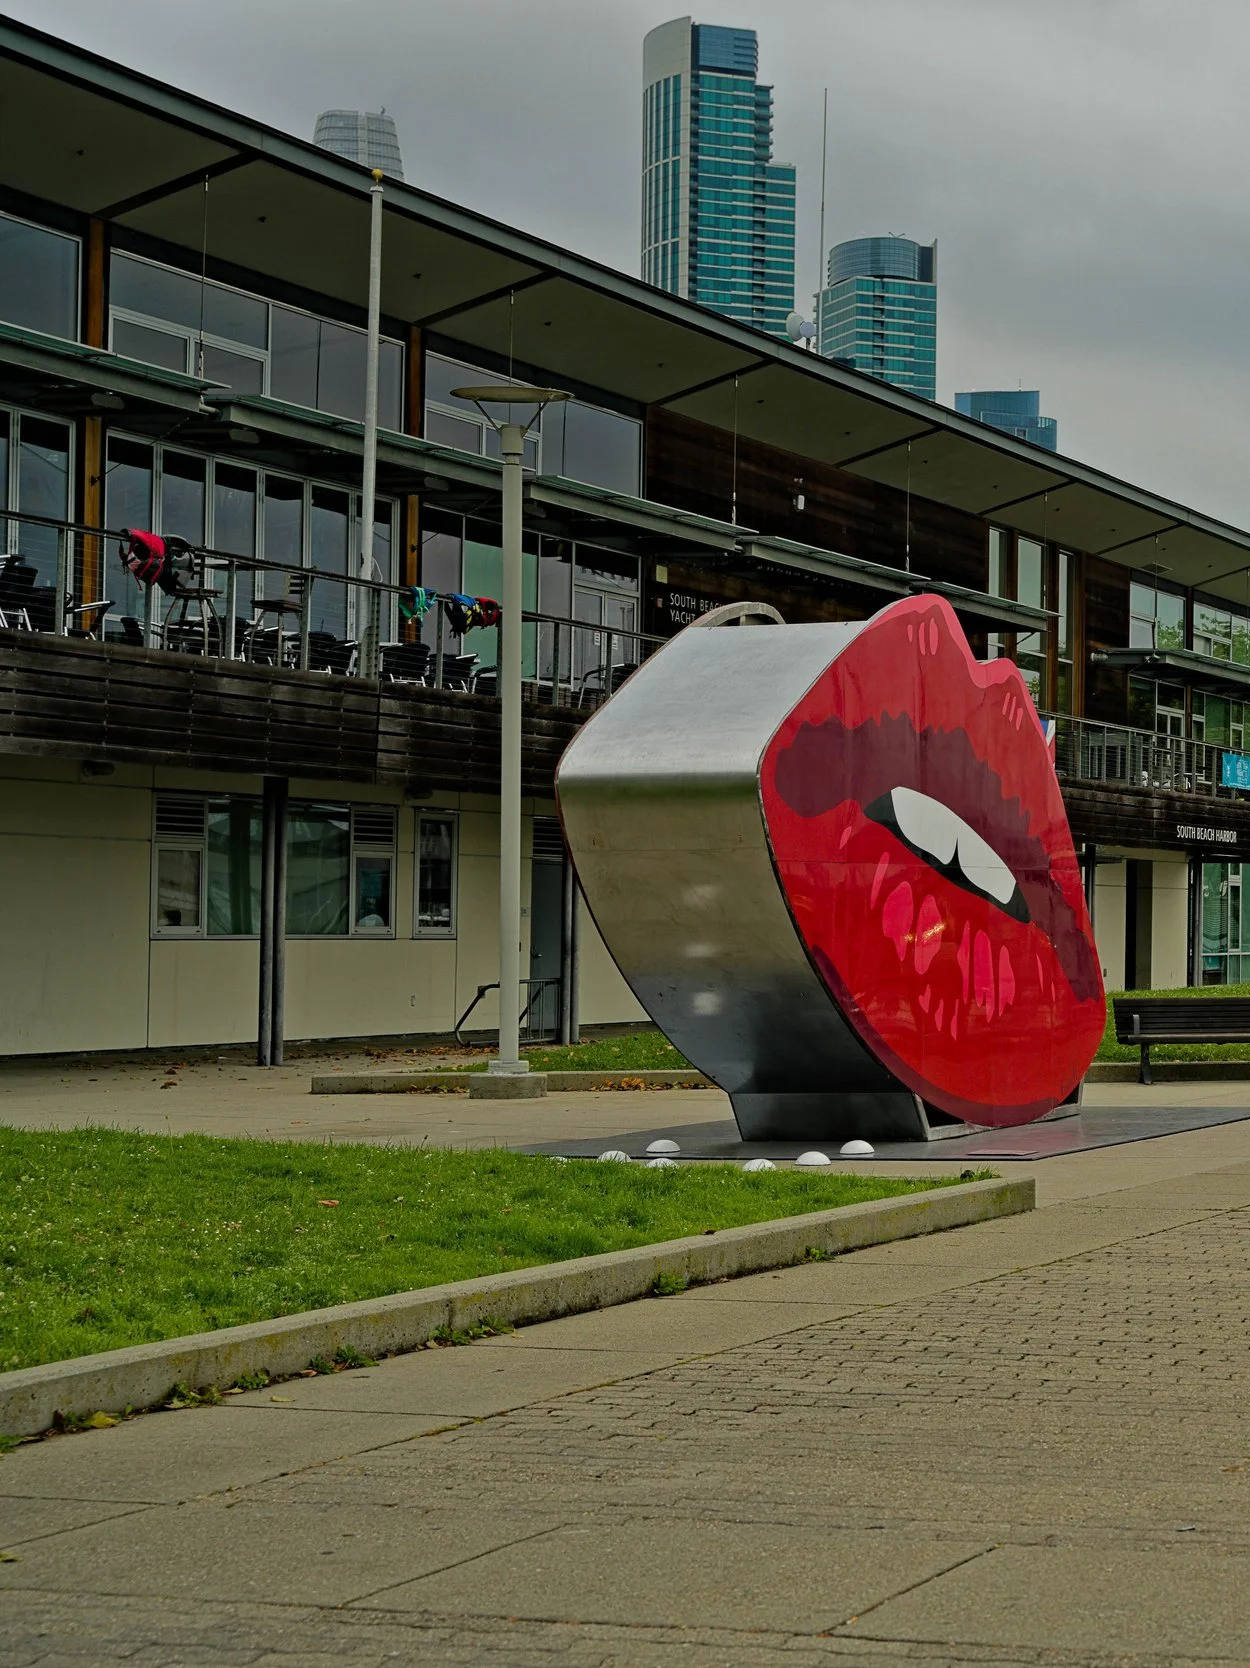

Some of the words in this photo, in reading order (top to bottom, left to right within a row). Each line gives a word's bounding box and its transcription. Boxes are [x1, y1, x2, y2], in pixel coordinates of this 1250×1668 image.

[670, 592, 696, 609] SOUTH
[699, 599, 723, 612] BEAC
[670, 609, 696, 624] YACHT
[1176, 825, 1196, 839] SOUTH
[1196, 827, 1215, 841] BEACH
[1216, 829, 1237, 843] HARBOR
